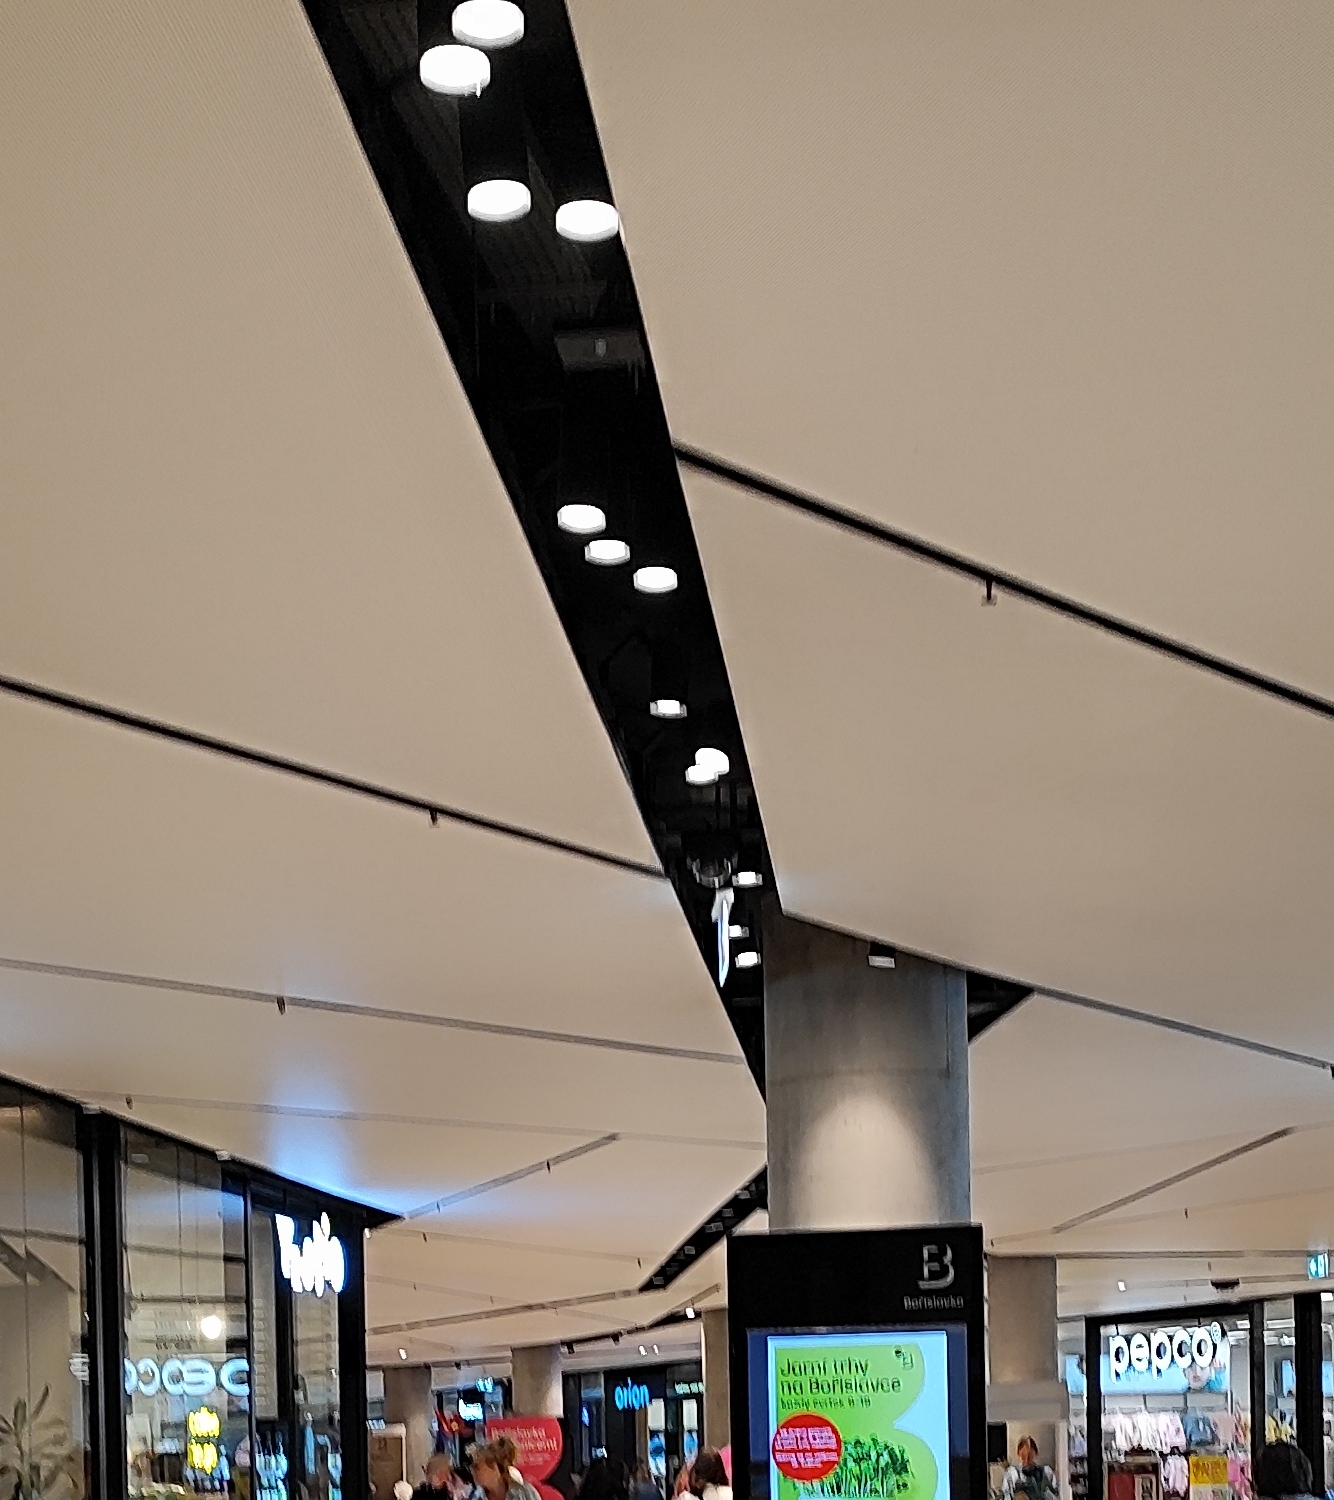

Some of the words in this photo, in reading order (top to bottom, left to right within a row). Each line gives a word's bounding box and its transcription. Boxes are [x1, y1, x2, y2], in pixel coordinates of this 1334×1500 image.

[833, 1356, 869, 1377] trhy
[1109, 1326, 1214, 1384] pepco
[615, 1377, 650, 1411] orion
[781, 1380, 804, 1396] na
[809, 1376, 902, 1396] Bořislavce
